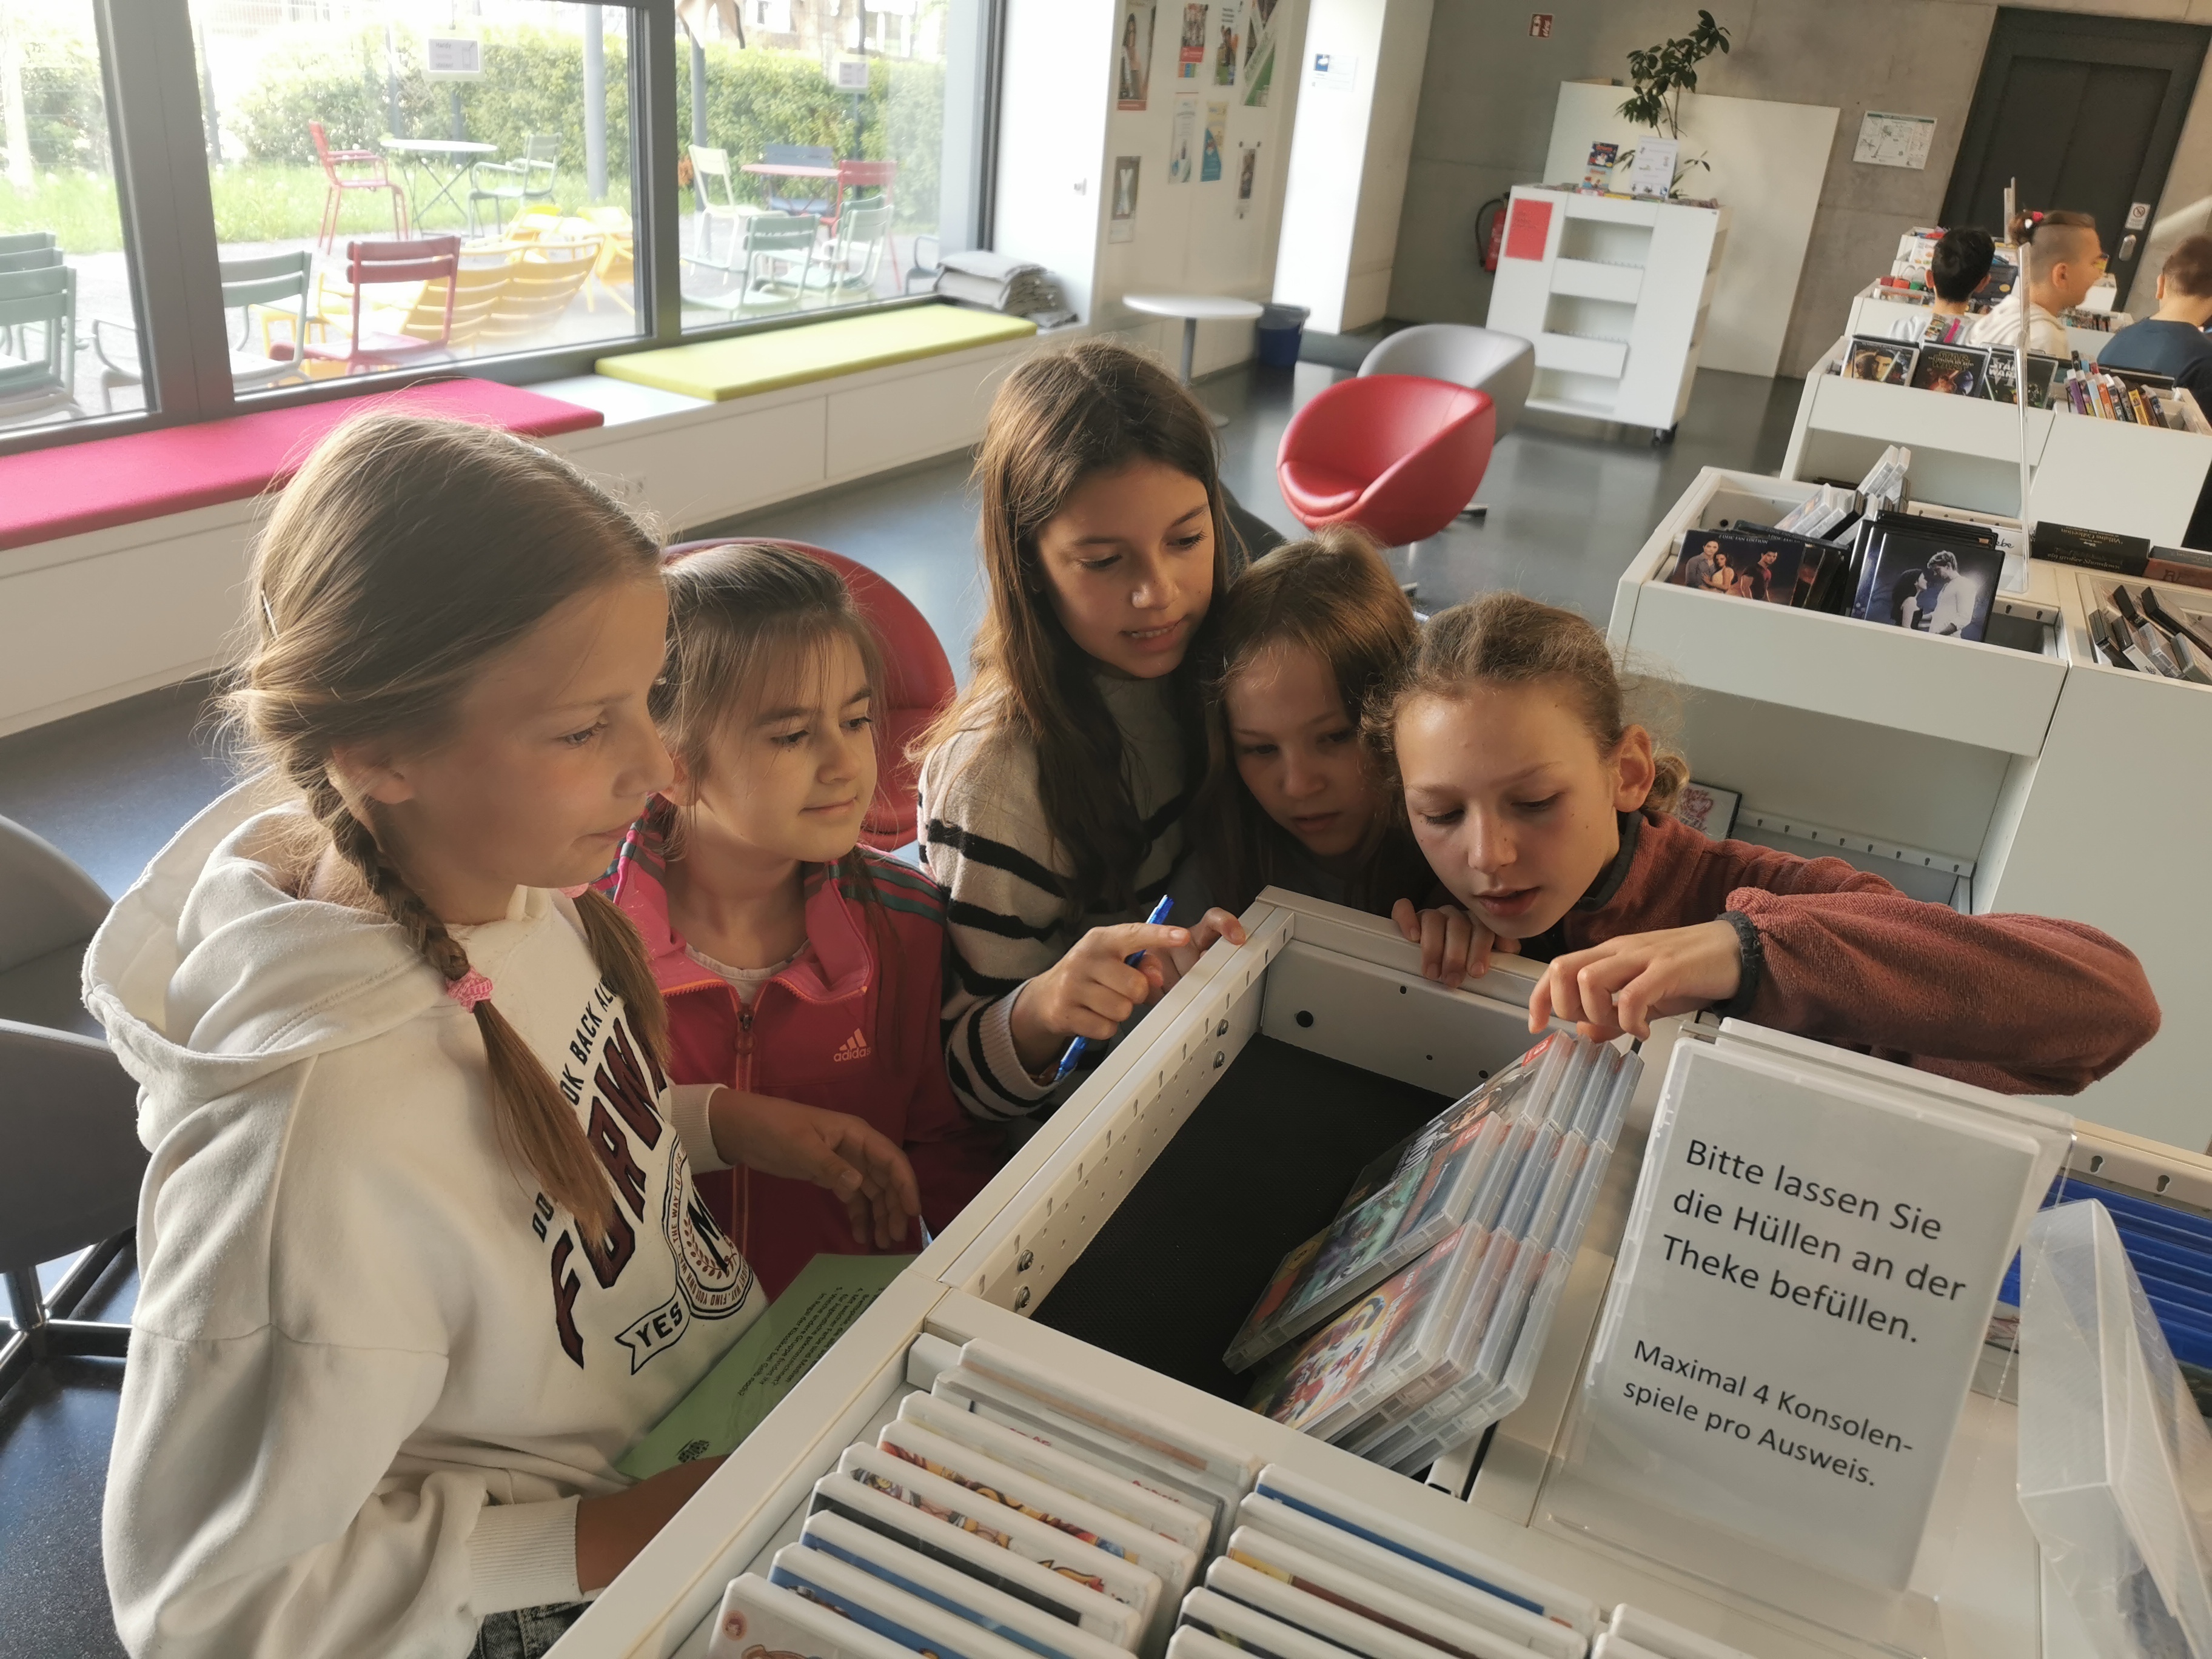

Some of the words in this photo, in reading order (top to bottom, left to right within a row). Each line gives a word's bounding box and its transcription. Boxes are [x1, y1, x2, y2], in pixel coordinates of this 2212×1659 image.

[2061, 528, 2095, 540] Collection
[569, 1001, 603, 1066] BACK
[833, 1047, 871, 1062] adidas
[559, 1062, 585, 1106] OK
[1686, 1138, 1765, 1185] Bitte
[1775, 1164, 1880, 1221] lassen
[1889, 1203, 1942, 1240] Sie
[1673, 1188, 1723, 1225] die
[1733, 1206, 1841, 1263] Hüllen
[1851, 1246, 1892, 1280] an
[1905, 1261, 1967, 1301] der
[678, 1252, 688, 1275] WAY
[686, 1272, 697, 1295] OWN
[1663, 1234, 1760, 1290] Theke
[1770, 1269, 1919, 1343] befüllen.
[710, 1293, 728, 1306] FIND
[816, 1293, 837, 1313] Welche
[635, 1301, 683, 1347] YES
[800, 1315, 820, 1333] andere
[774, 1327, 799, 1351] Klassiker
[780, 1335, 803, 1356] Gruppe
[785, 1359, 808, 1383] Medien
[1634, 1339, 1746, 1396] Maximal
[1752, 1384, 1770, 1406] 4
[1777, 1389, 1914, 1453] Konsolen-
[1623, 1379, 1699, 1423] spiele
[1704, 1410, 1752, 1441] pro
[1757, 1428, 1877, 1486] Ausweis.
